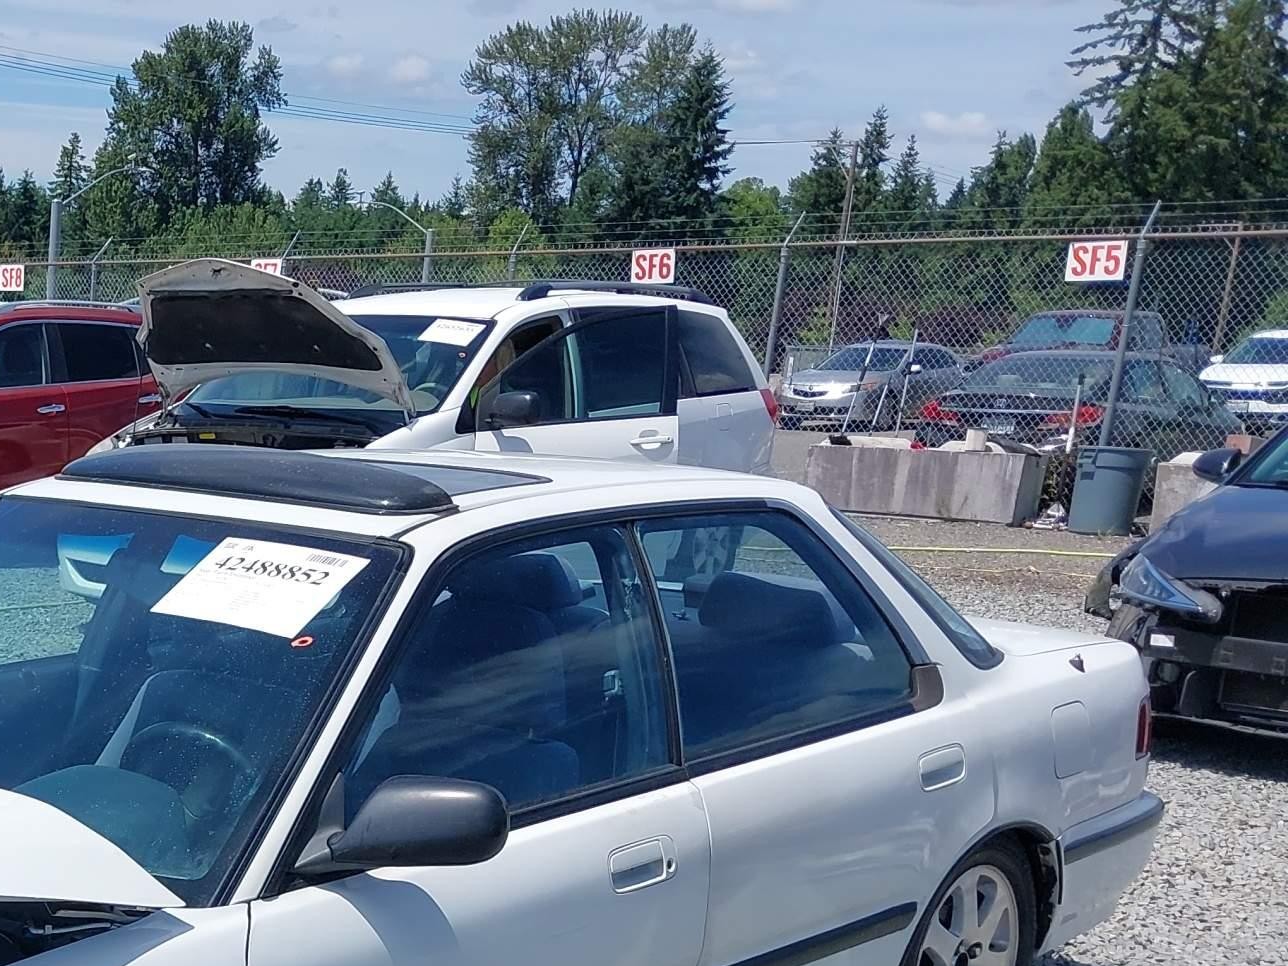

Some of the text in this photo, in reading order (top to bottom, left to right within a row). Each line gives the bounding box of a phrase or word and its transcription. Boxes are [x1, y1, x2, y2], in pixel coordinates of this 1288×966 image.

[635, 253, 671, 280] SF6
[1071, 245, 1121, 276] SF5
[2, 268, 22, 288] SF8
[215, 556, 330, 585] 42488852
